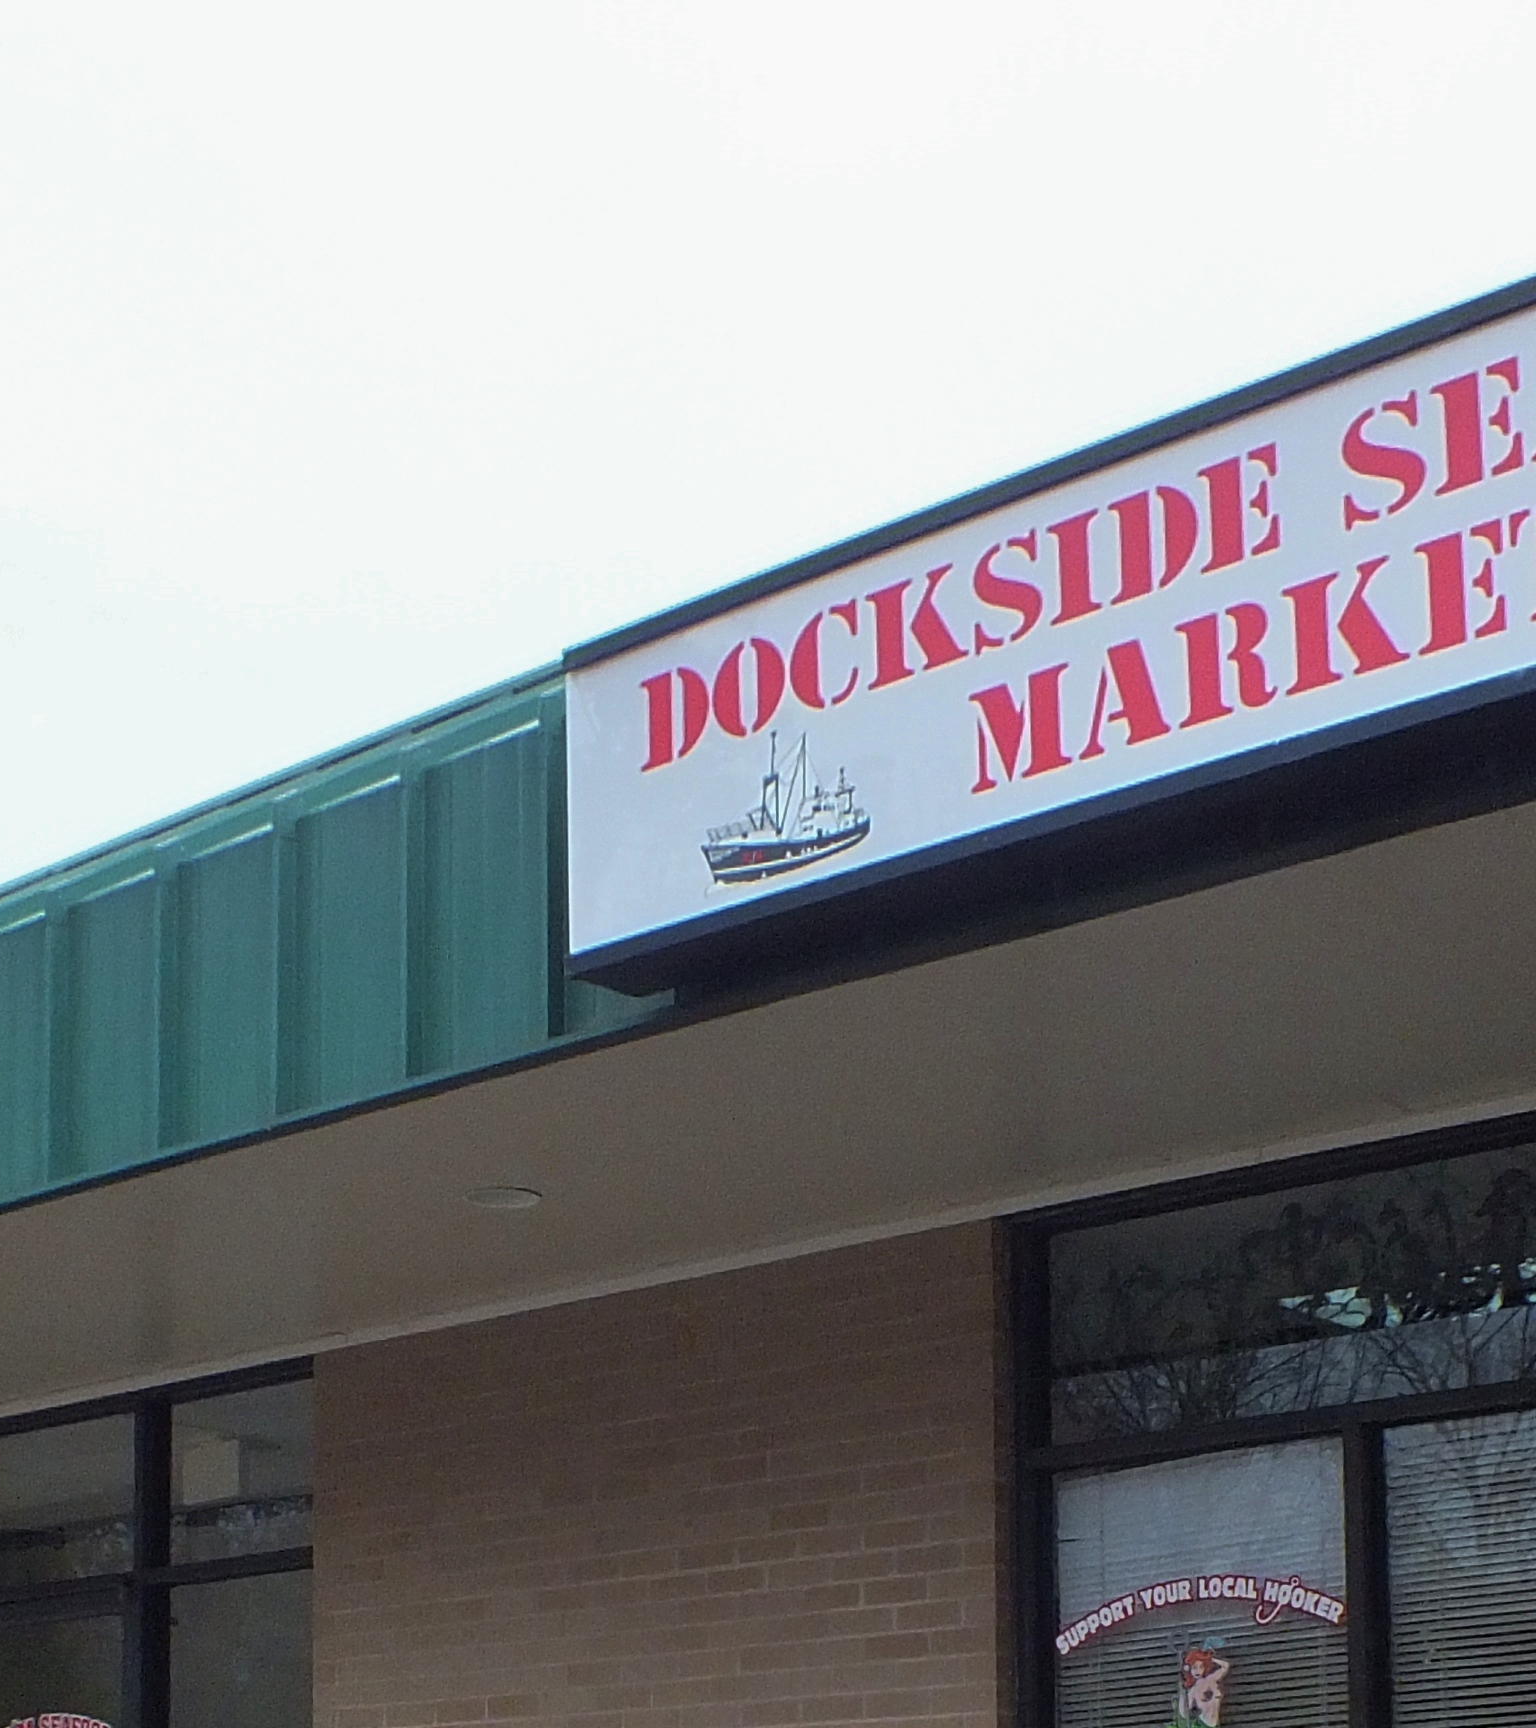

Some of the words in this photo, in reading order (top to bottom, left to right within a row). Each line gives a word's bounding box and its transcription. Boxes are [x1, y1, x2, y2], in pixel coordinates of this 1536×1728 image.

[640, 443, 1282, 772] DOCKSIDE
[1056, 1595, 1136, 1656] SUPPORT
[1141, 1577, 1192, 1611] YOUR
[1197, 1575, 1258, 1601] LOCAL
[1263, 1576, 1346, 1625] HOOKER
